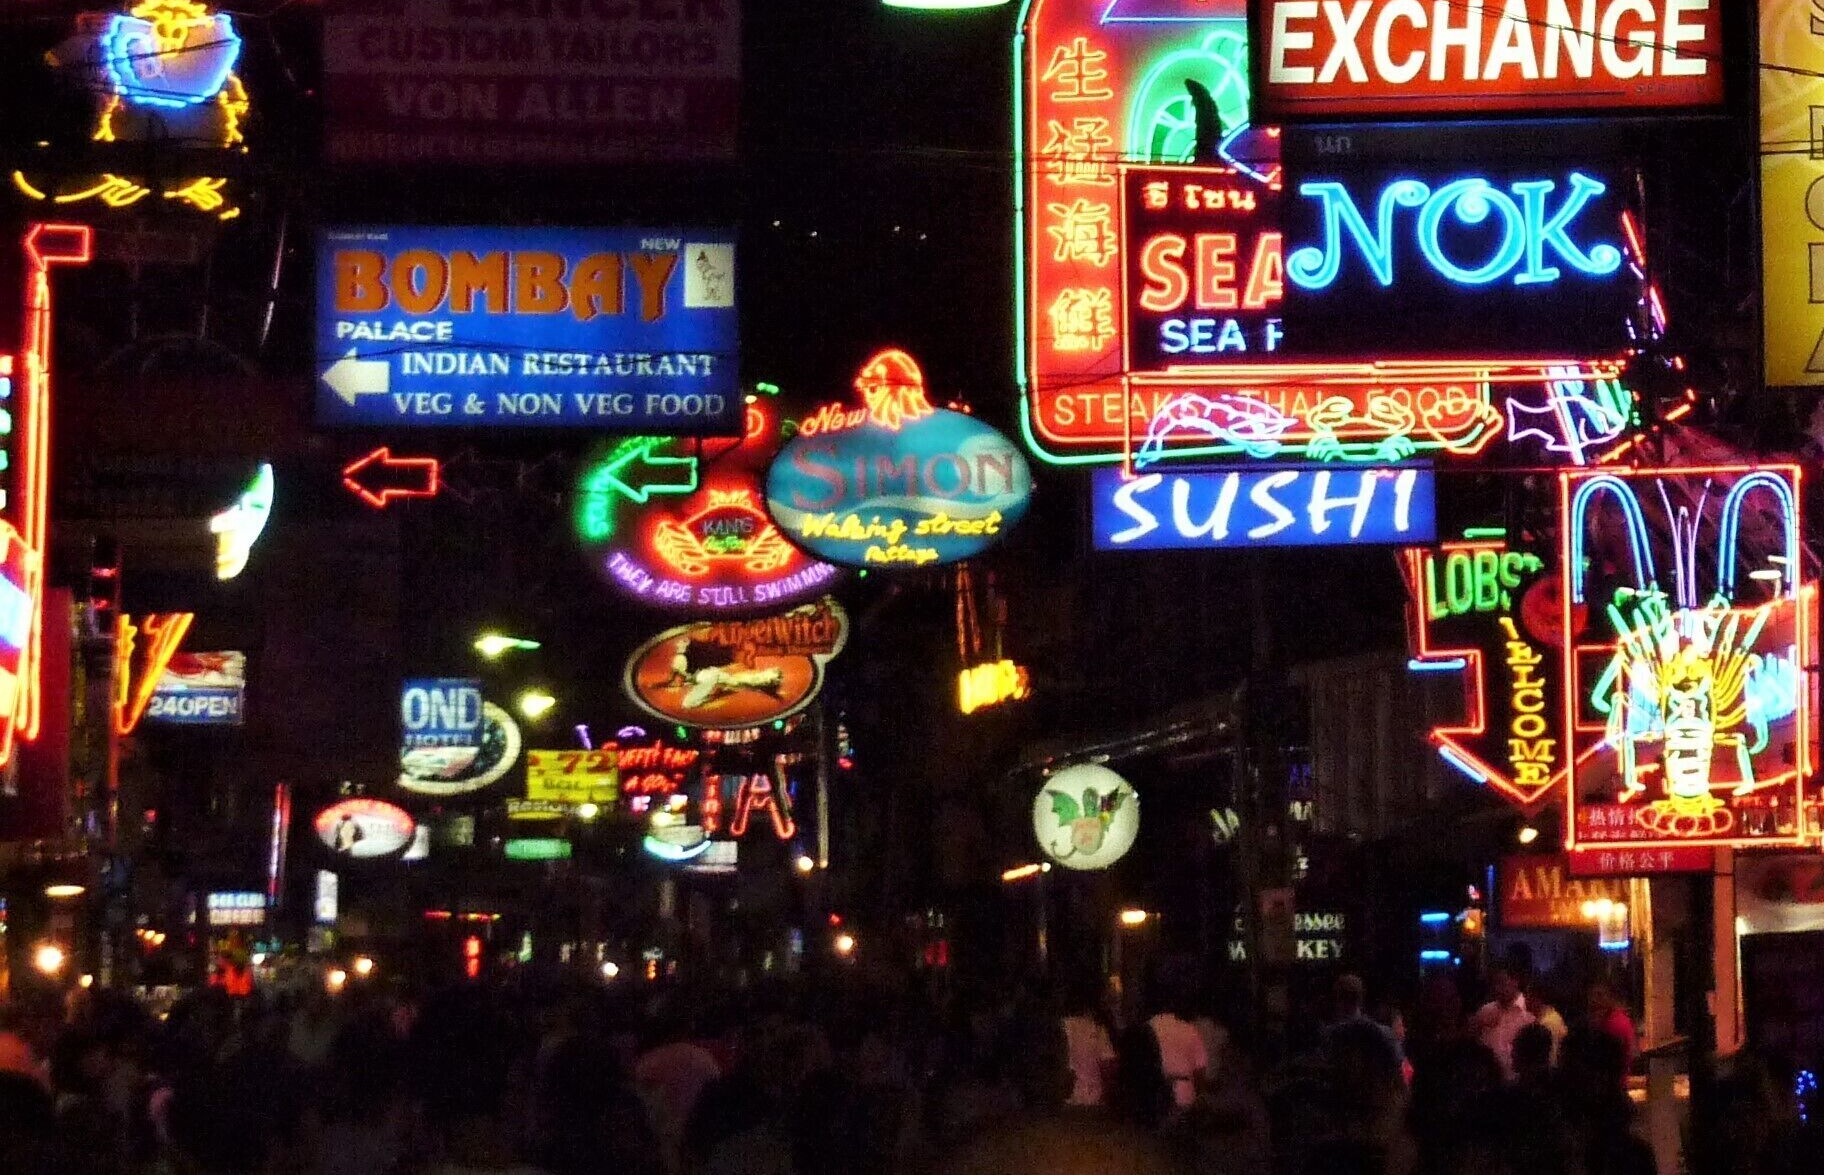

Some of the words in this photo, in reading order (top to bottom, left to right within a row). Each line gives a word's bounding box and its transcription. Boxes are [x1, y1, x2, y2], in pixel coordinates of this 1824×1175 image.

[357, 28, 536, 62] CUSTOM
[550, 29, 719, 64] TAILORS
[383, 80, 500, 120] VON
[515, 81, 688, 122] ALLEN
[1286, 172, 1622, 290] NOK
[334, 250, 679, 322] BOMBAY
[1140, 232, 1283, 313] SEA
[336, 321, 454, 343] PALACE
[1161, 319, 1247, 353] SEA
[402, 352, 510, 377] INDIAN
[522, 352, 715, 377] RESTAURANT
[394, 393, 453, 415] VEG
[464, 393, 486, 415] &
[497, 393, 562, 416] NON
[576, 392, 633, 416] VEG
[645, 393, 726, 416] FOOD
[792, 442, 1013, 510] SIMON
[1108, 468, 1417, 544] SUSHI
[608, 552, 654, 594] THEY
[656, 580, 692, 604] ARE
[697, 586, 748, 606] STILL
